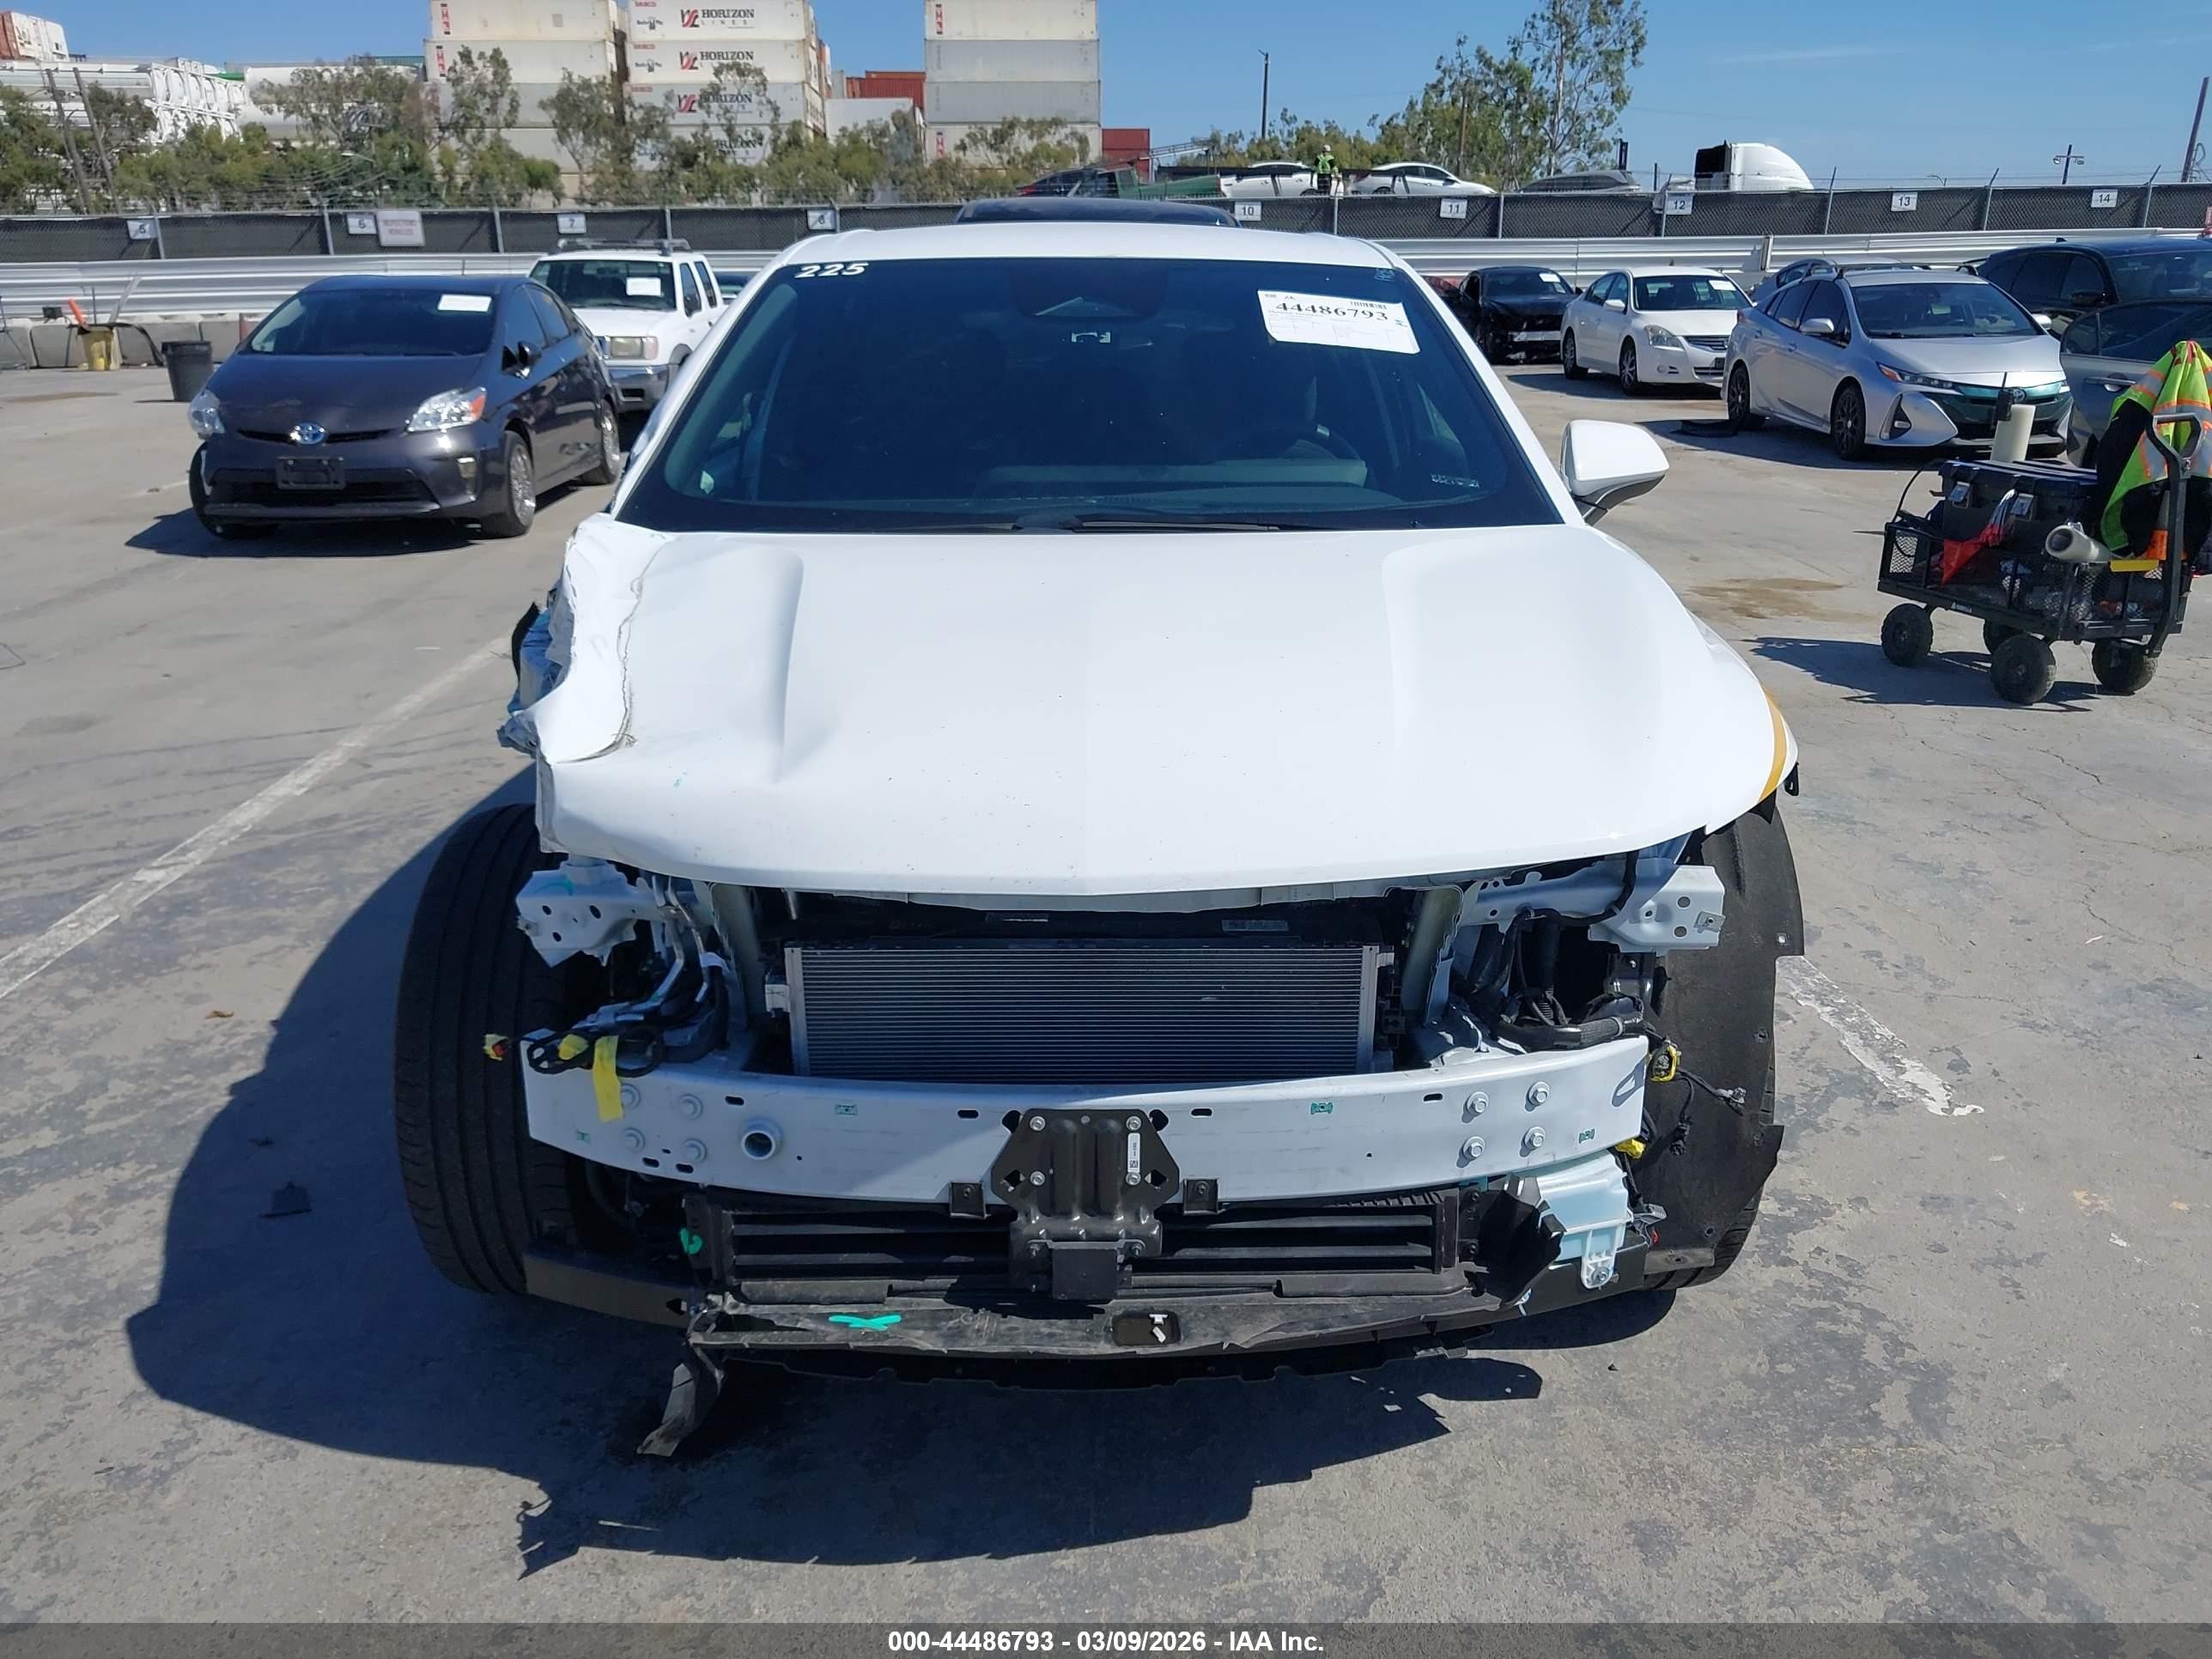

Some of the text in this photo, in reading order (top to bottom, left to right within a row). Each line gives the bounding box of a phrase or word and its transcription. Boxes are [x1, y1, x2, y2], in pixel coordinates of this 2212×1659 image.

[701, 9, 755, 18] HORIZON
[700, 51, 754, 61] HORIZON
[1899, 197, 1911, 207] 13
[2099, 193, 2111, 204] 14
[1449, 204, 1460, 214] 11
[1674, 200, 1686, 210] 12
[1242, 206, 1255, 216] 10
[568, 219, 575, 228] 7
[794, 261, 870, 278] 225
[1275, 301, 1389, 321] 44486793
